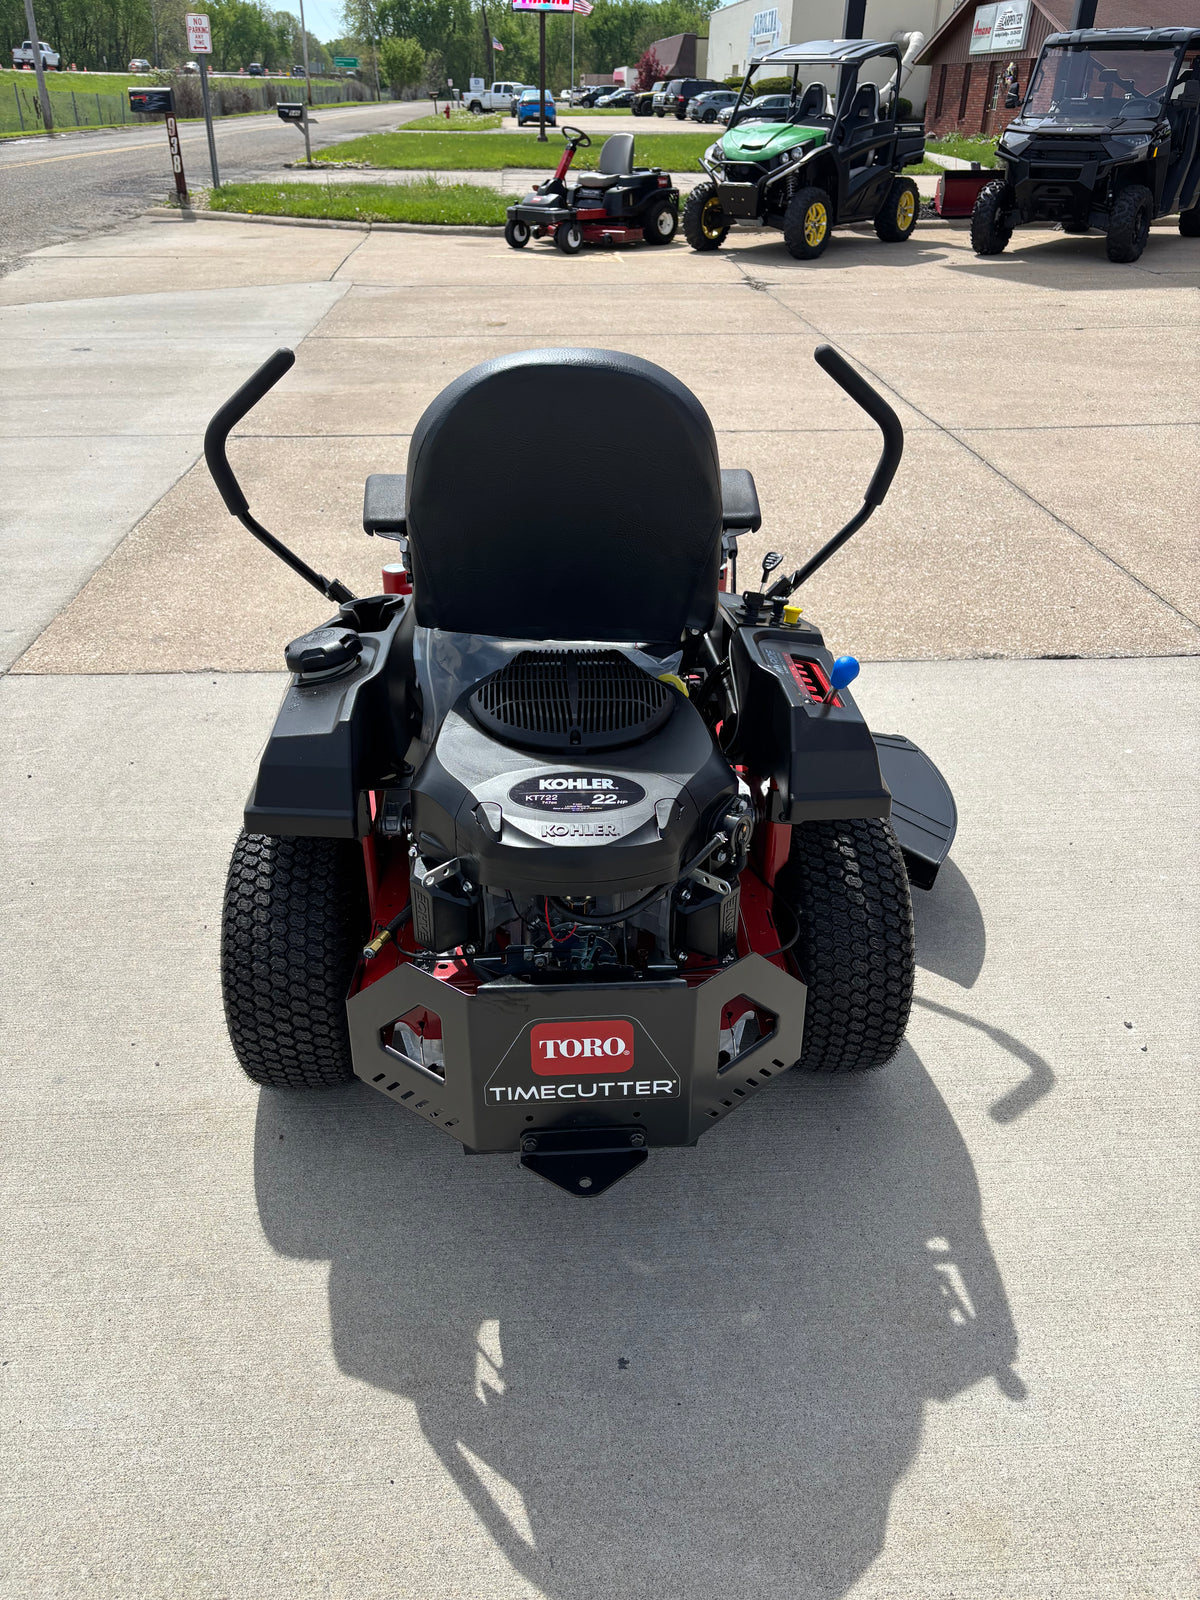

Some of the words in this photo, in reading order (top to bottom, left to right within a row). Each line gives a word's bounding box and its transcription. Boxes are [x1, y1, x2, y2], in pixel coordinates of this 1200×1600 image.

[192, 17, 202, 25] NO
[167, 118, 181, 173] 938
[525, 794, 558, 802] KT722
[591, 794, 618, 805] 22
[539, 1037, 627, 1059] TORO
[489, 1080, 673, 1101] TIMECUTTER
